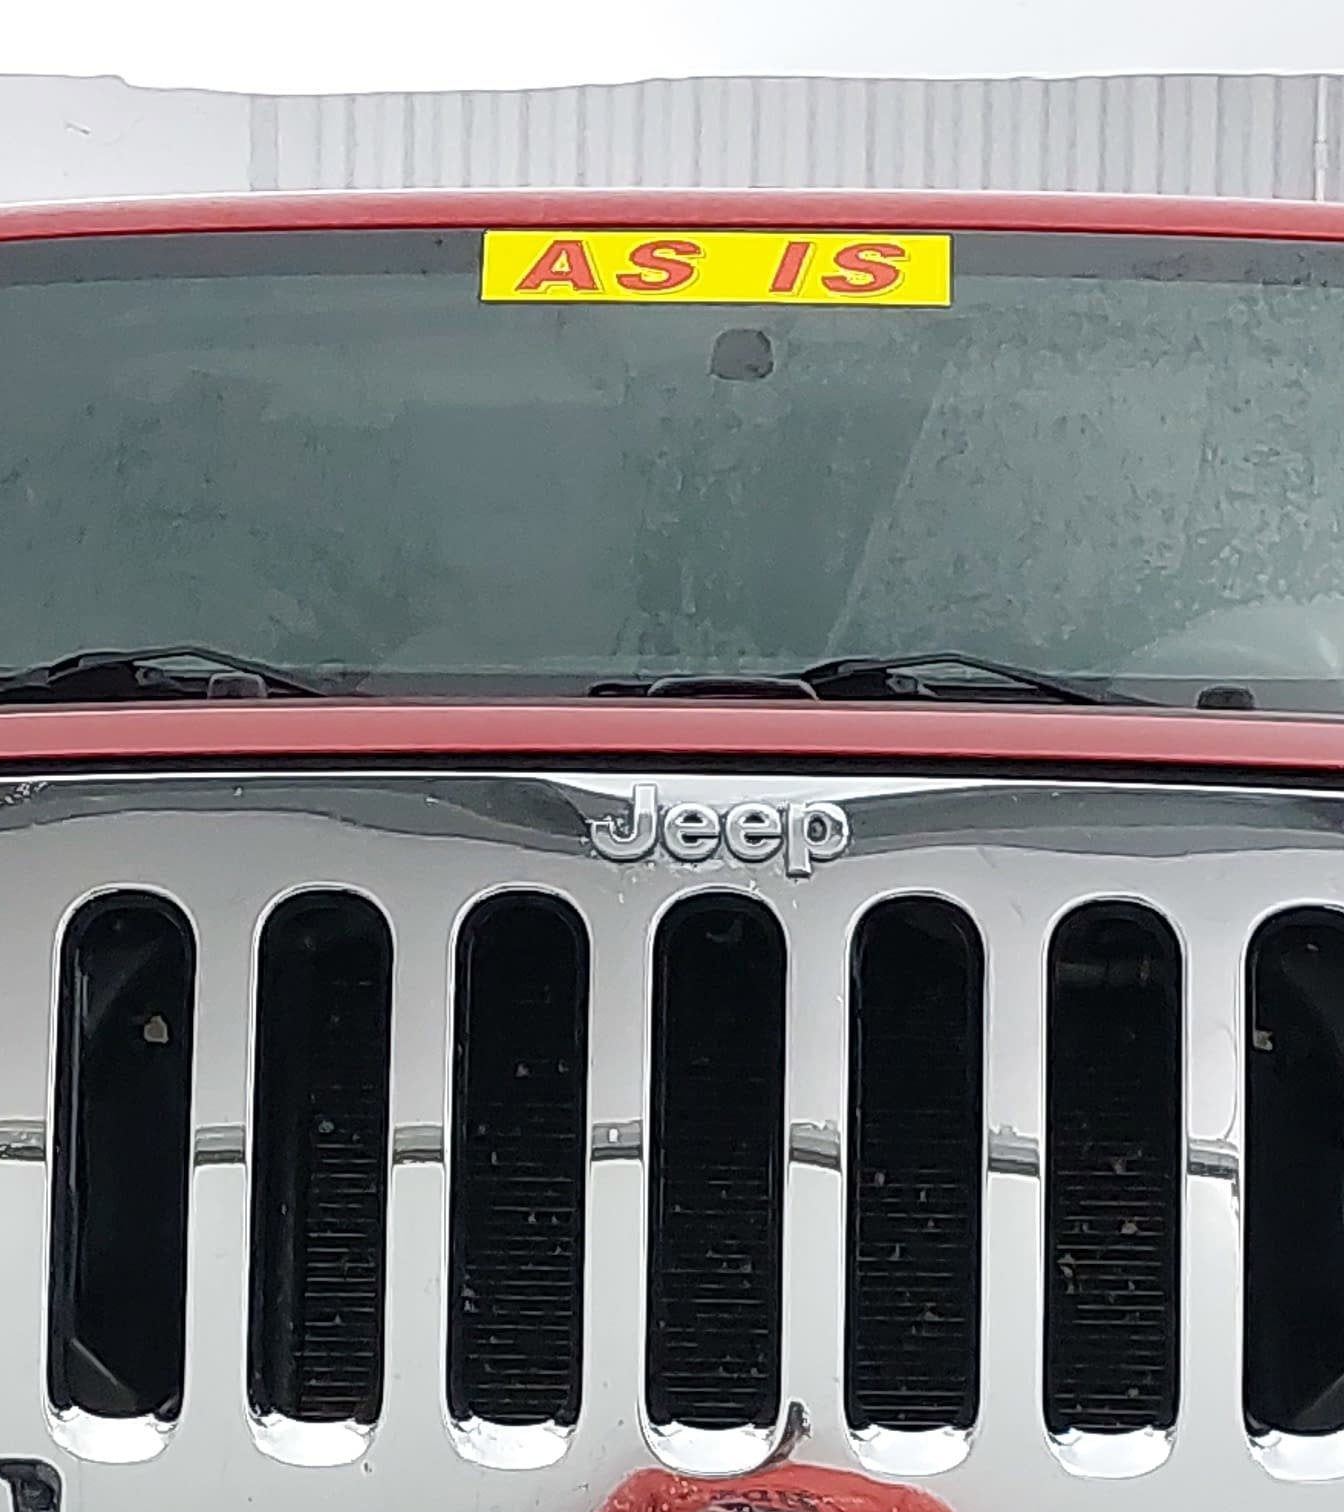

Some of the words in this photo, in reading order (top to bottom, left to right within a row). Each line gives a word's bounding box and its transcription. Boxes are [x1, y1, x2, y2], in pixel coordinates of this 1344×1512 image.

[516, 239, 703, 292] AS
[769, 241, 907, 293] IS
[588, 783, 850, 878] Jeep
